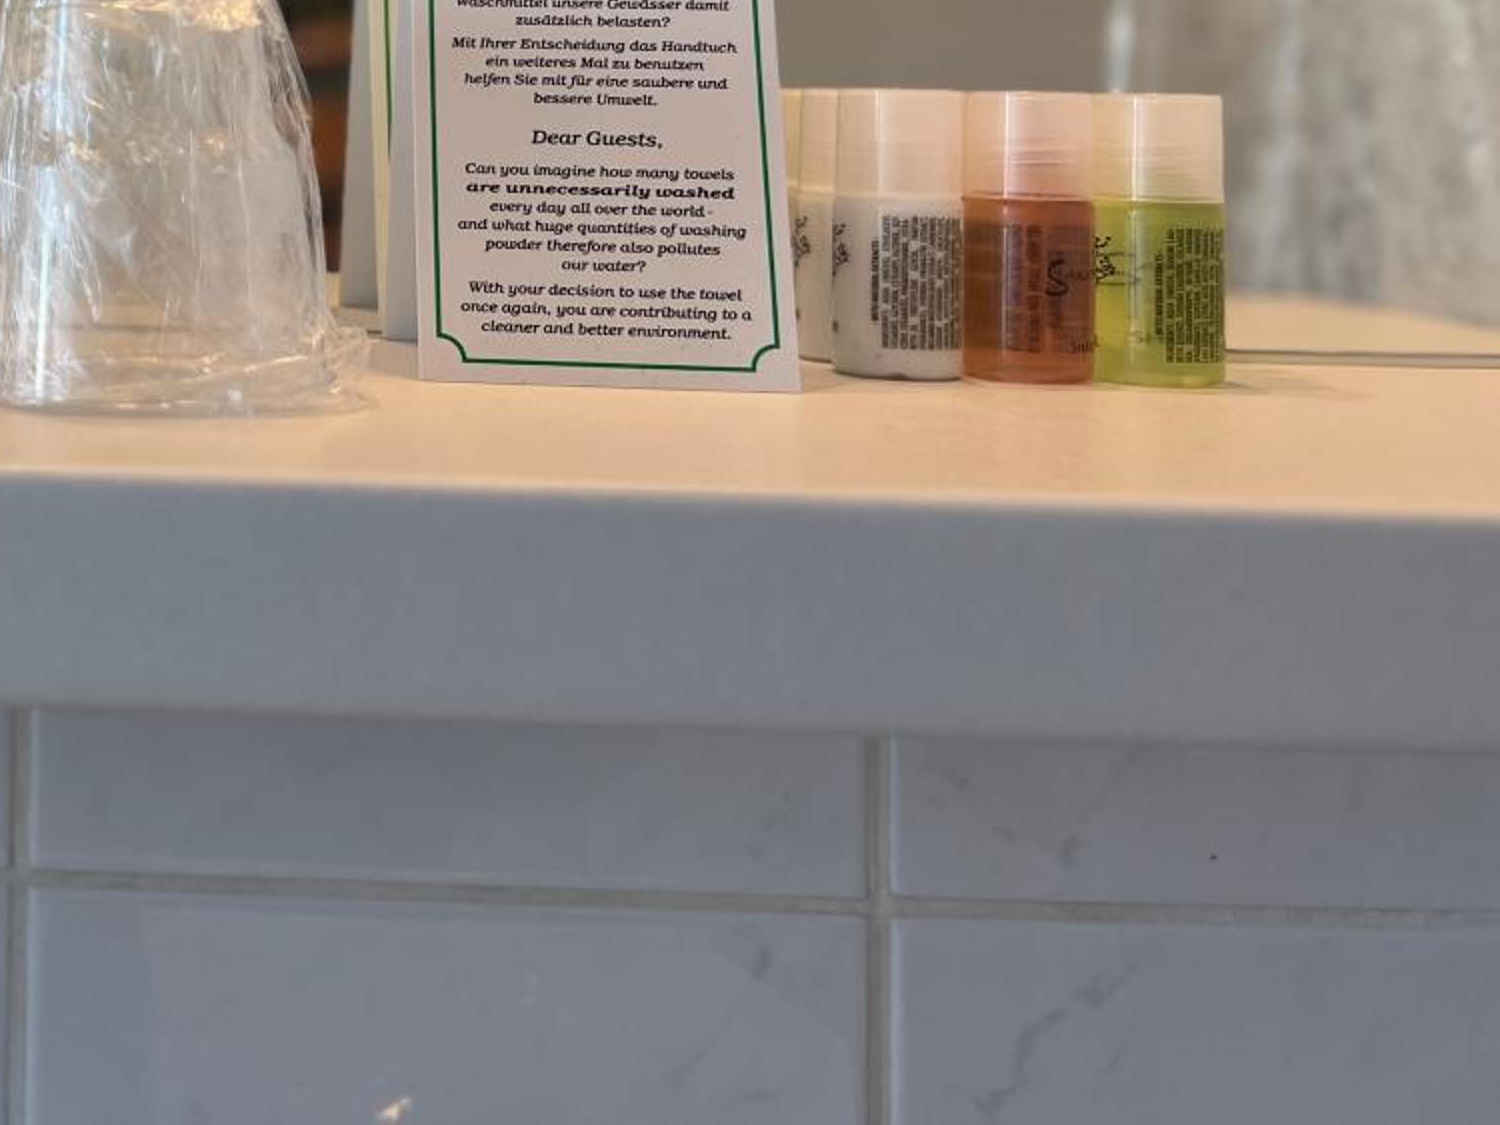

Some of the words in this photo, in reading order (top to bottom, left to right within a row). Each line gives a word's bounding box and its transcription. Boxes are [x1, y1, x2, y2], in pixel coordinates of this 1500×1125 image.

[552, 0, 604, 9] unsere
[685, 0, 729, 10] damit
[597, 16, 671, 28] belasten?
[452, 37, 476, 48] Mit
[479, 37, 517, 49] Ihrer
[519, 38, 625, 53] Entscheidung
[629, 40, 657, 52] das
[661, 41, 738, 53] Handtuch
[485, 55, 509, 67] ein
[513, 56, 577, 68] weiteres
[580, 57, 609, 69] Mal
[612, 60, 631, 69] zu
[634, 58, 704, 70] benutzen
[464, 72, 511, 87] helfen
[514, 73, 538, 86] Sie
[541, 74, 567, 86] mit
[569, 74, 594, 89] für
[596, 76, 629, 87] eine
[632, 76, 694, 88] saubere
[697, 78, 728, 89] und
[533, 92, 592, 104] bessere
[532, 130, 582, 145] Dear
[586, 131, 663, 148] Guests,
[465, 162, 496, 175] Can
[500, 166, 530, 178] you
[533, 164, 596, 179] imagine
[599, 166, 633, 178] how
[635, 169, 679, 182] many
[684, 168, 735, 180] towels
[466, 184, 501, 194] are
[506, 184, 651, 198] unnecessarily
[655, 186, 735, 199] washed
[489, 203, 533, 216] every
[536, 201, 567, 217] day
[570, 202, 591, 214] all
[594, 205, 629, 215] over
[631, 204, 657, 216] the
[660, 205, 706, 217] world
[457, 218, 488, 230] and
[491, 219, 531, 232] what
[535, 220, 574, 235] huge
[577, 222, 657, 236] quantities
[659, 223, 678, 238] of
[679, 224, 747, 240] washing
[485, 238, 543, 252] powder
[547, 239, 617, 255] therefore
[619, 241, 654, 254] also
[657, 242, 721, 258] pollutes
[561, 261, 589, 271] our
[592, 260, 647, 272] water?
[468, 281, 505, 294] With
[508, 285, 546, 298] your
[548, 284, 615, 296] decision
[619, 286, 635, 298] to
[638, 289, 667, 298] use
[670, 287, 696, 299] the
[699, 289, 743, 300] towel
[460, 303, 499, 313] once
[556, 306, 587, 318] you
[590, 306, 617, 316] are
[619, 306, 717, 321] contributing
[722, 308, 738, 320] to
[741, 311, 752, 320] a
[481, 320, 541, 334] cleaner
[543, 322, 574, 335] and
[578, 323, 625, 336] better
[627, 327, 731, 338] environment.
